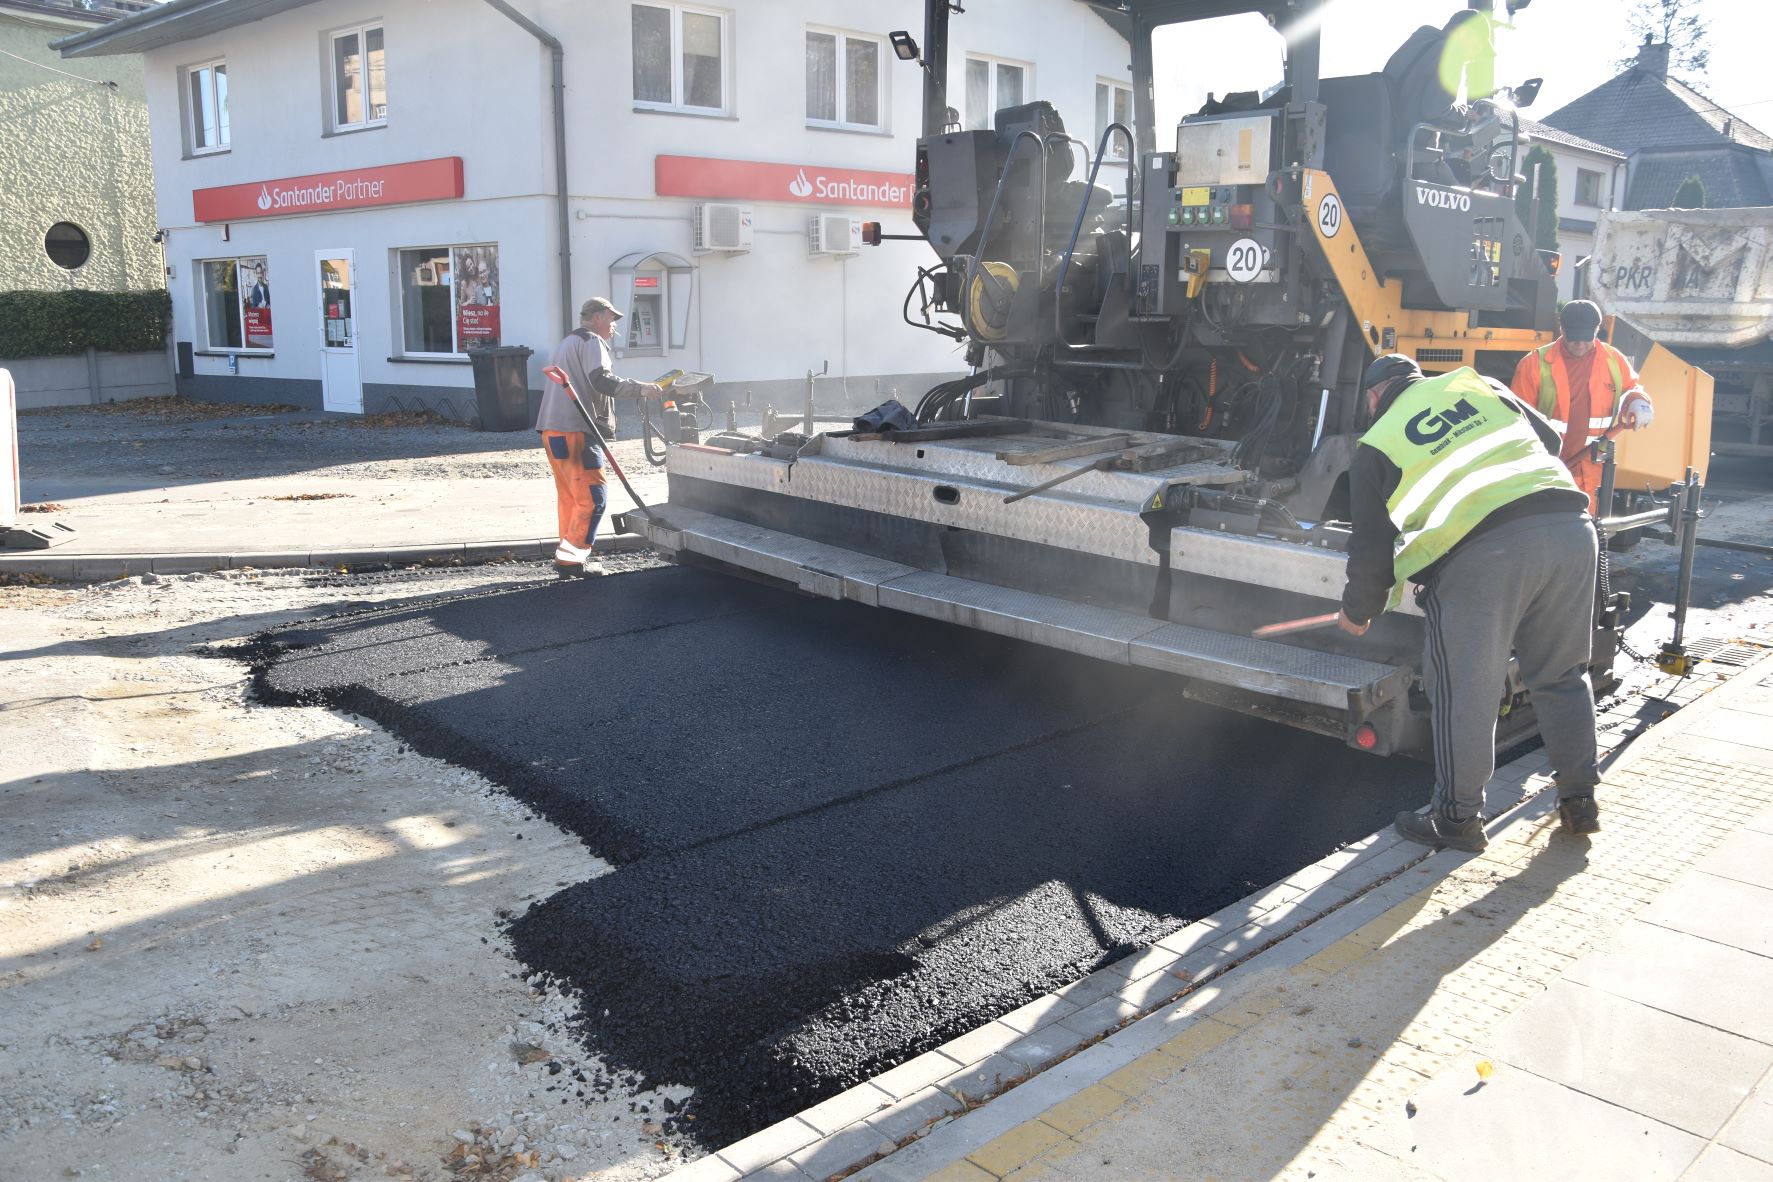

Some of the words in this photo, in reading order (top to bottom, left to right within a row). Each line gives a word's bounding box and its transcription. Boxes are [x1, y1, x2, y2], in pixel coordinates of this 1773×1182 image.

[272, 183, 334, 208] Santander
[337, 179, 384, 200] Partner
[816, 176, 906, 203] Santander
[1416, 187, 1470, 212] VOLVO
[1321, 202, 1338, 228] 20
[1231, 246, 1257, 272] 20
[1614, 265, 1652, 289] PKR
[1405, 398, 1480, 446] GM
